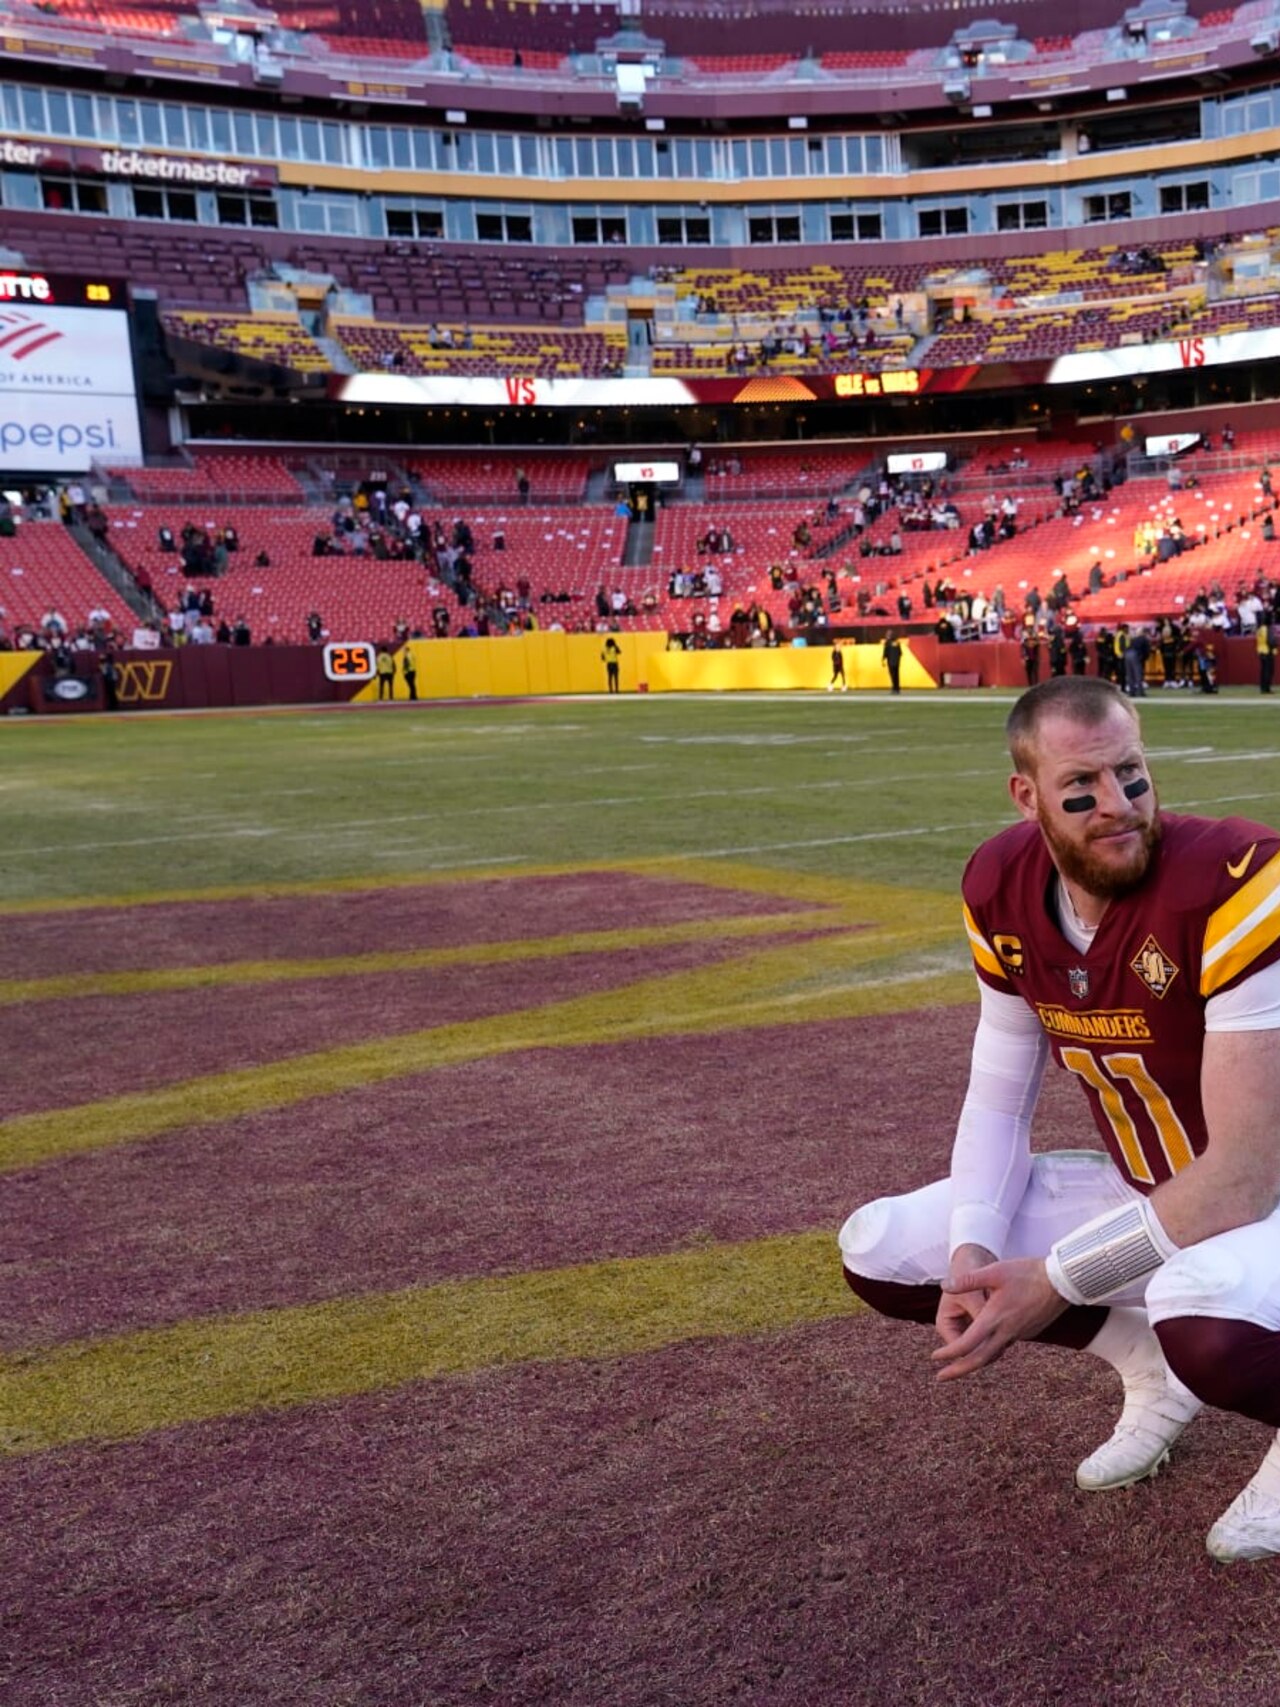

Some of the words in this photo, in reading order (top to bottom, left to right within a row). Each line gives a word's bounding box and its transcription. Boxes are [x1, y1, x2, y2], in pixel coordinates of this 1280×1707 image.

[101, 151, 250, 185] ticketmaster
[1178, 336, 1205, 368] VS
[21, 374, 93, 386] AMERICA
[505, 374, 536, 406] VS
[0, 419, 115, 455] pepsi
[332, 647, 369, 675] 25
[993, 934, 1023, 967] C
[1038, 1007, 1152, 1039] COMMANDERS
[1059, 1046, 1196, 1186] 11
